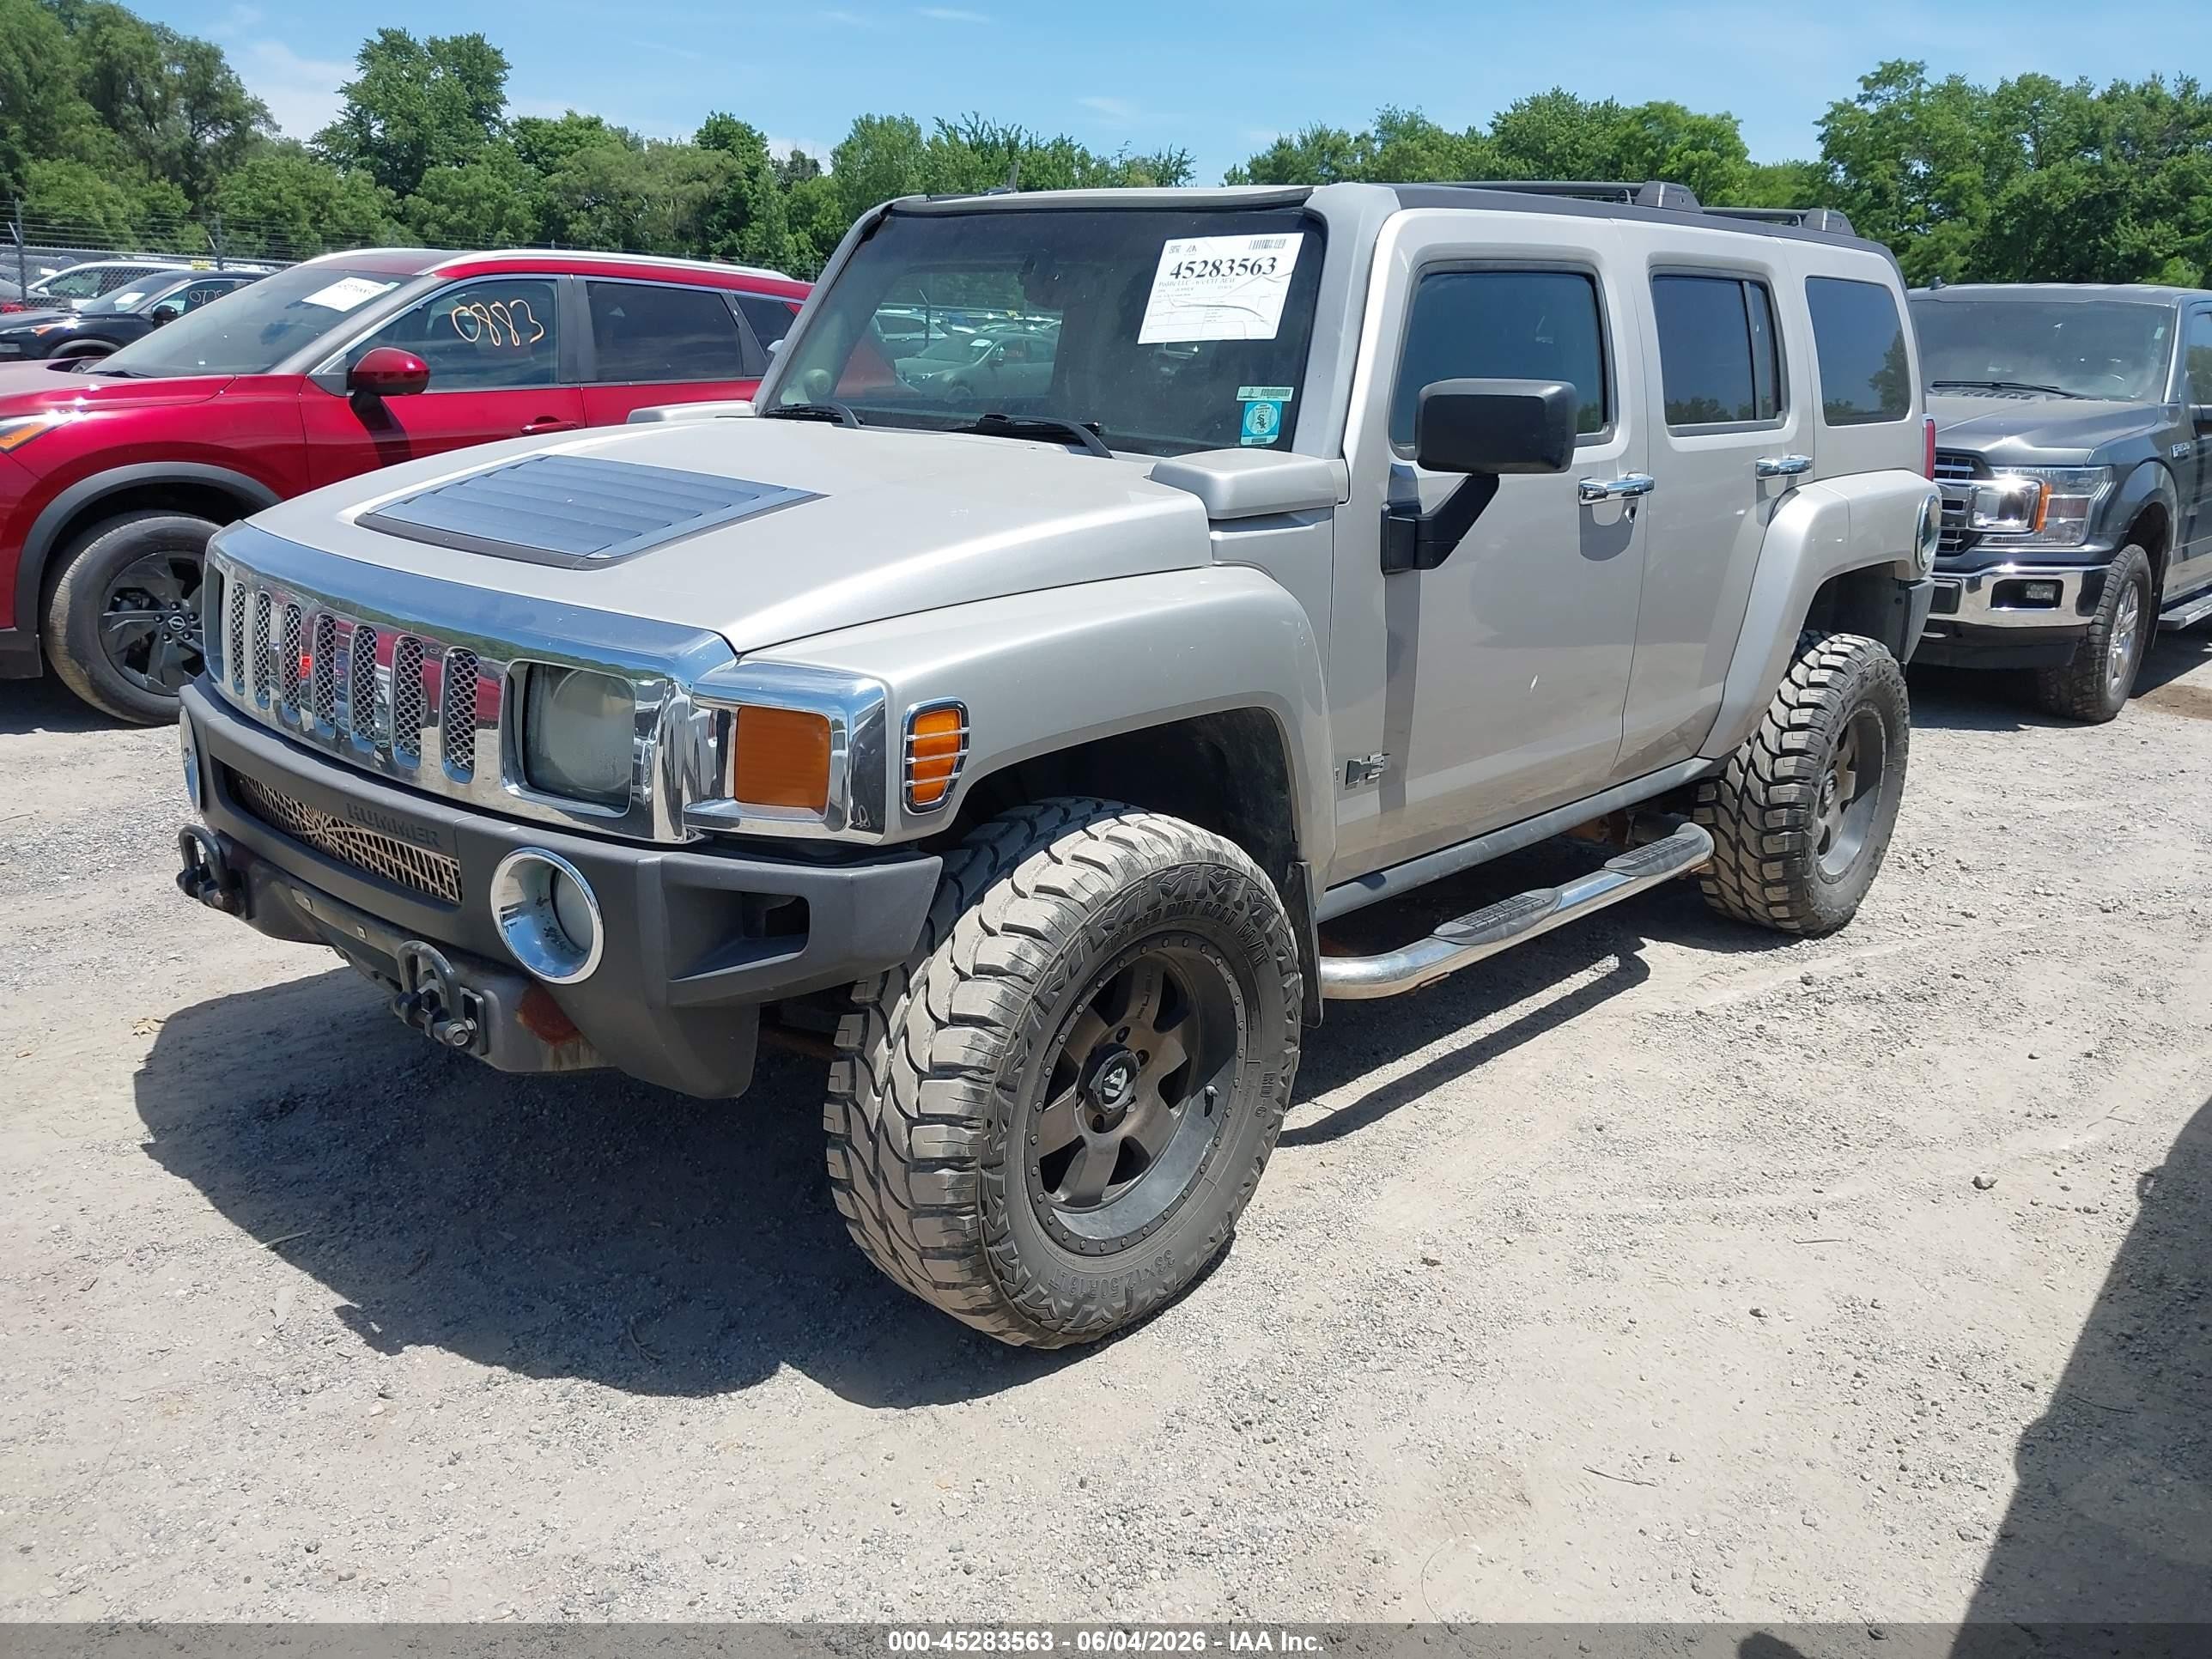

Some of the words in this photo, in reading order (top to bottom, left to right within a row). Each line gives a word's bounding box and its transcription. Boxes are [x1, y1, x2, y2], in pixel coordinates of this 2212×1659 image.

[1169, 257, 1277, 279] 45283563
[452, 299, 544, 347] 0883
[346, 803, 443, 848] HUMMER
[1201, 900, 1238, 926] ROAD
[1235, 921, 1271, 966] M/T
